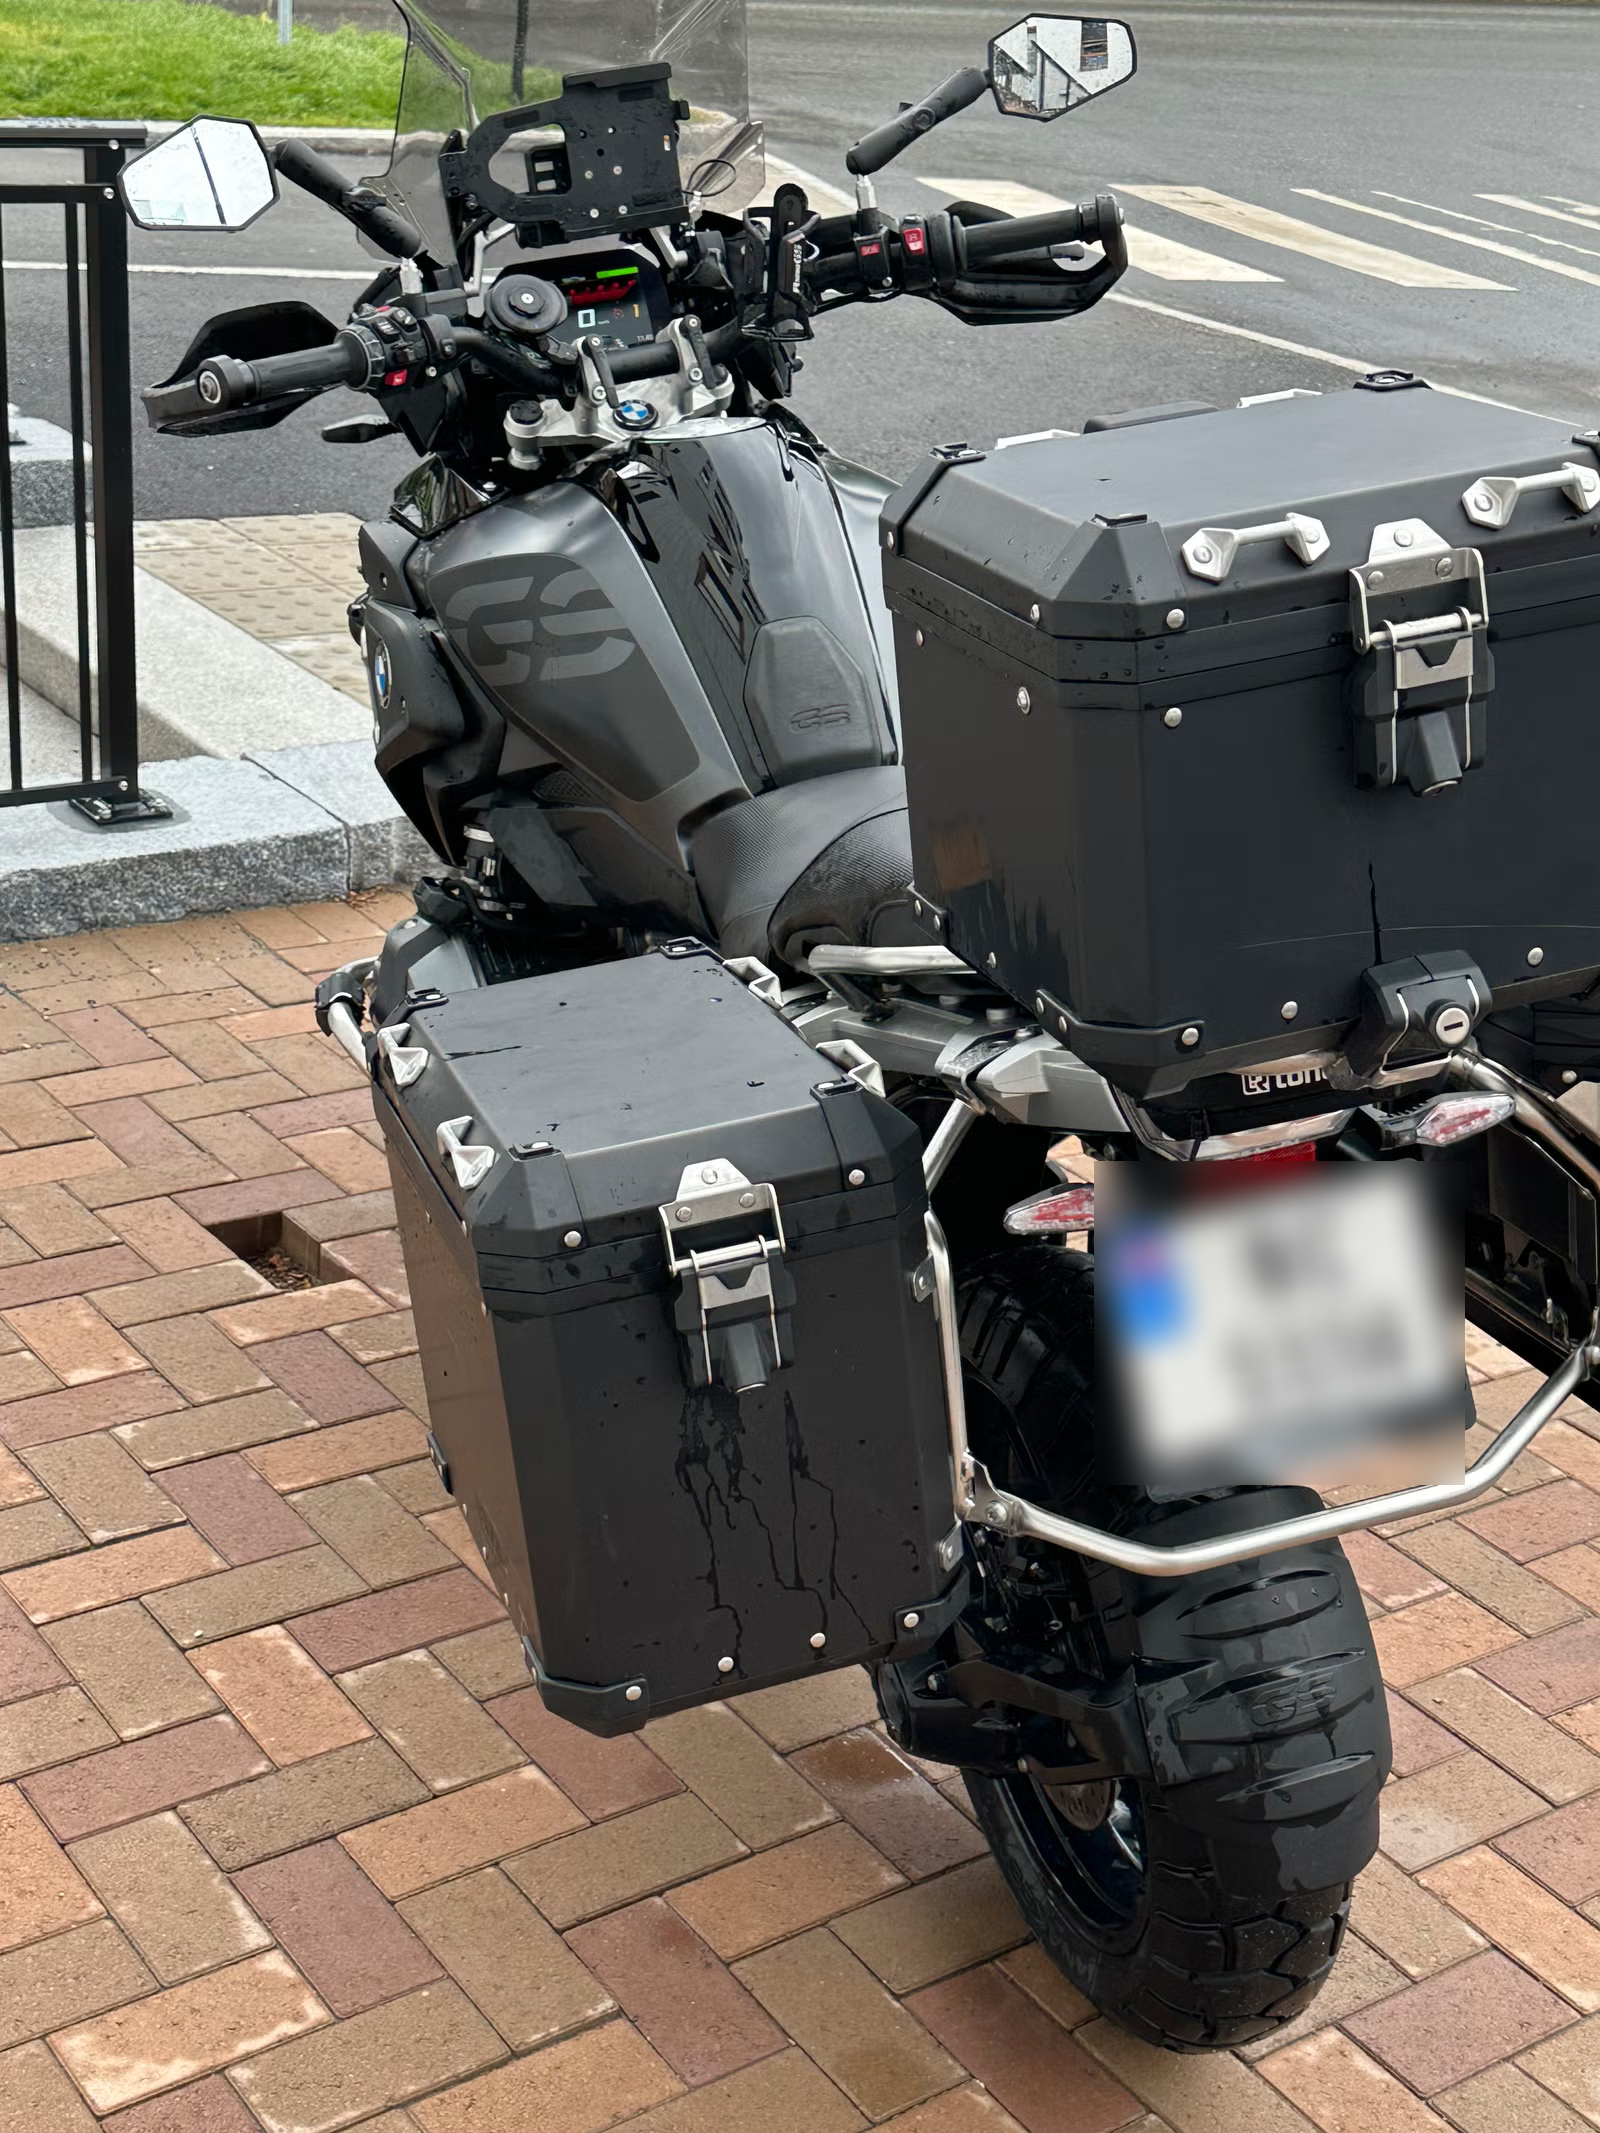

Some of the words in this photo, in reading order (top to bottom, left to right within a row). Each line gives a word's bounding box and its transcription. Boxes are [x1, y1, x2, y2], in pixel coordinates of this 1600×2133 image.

[578, 309, 596, 328] 0
[445, 568, 636, 687] GS
[789, 703, 850, 734] GS
[1250, 1672, 1335, 1726] GS
